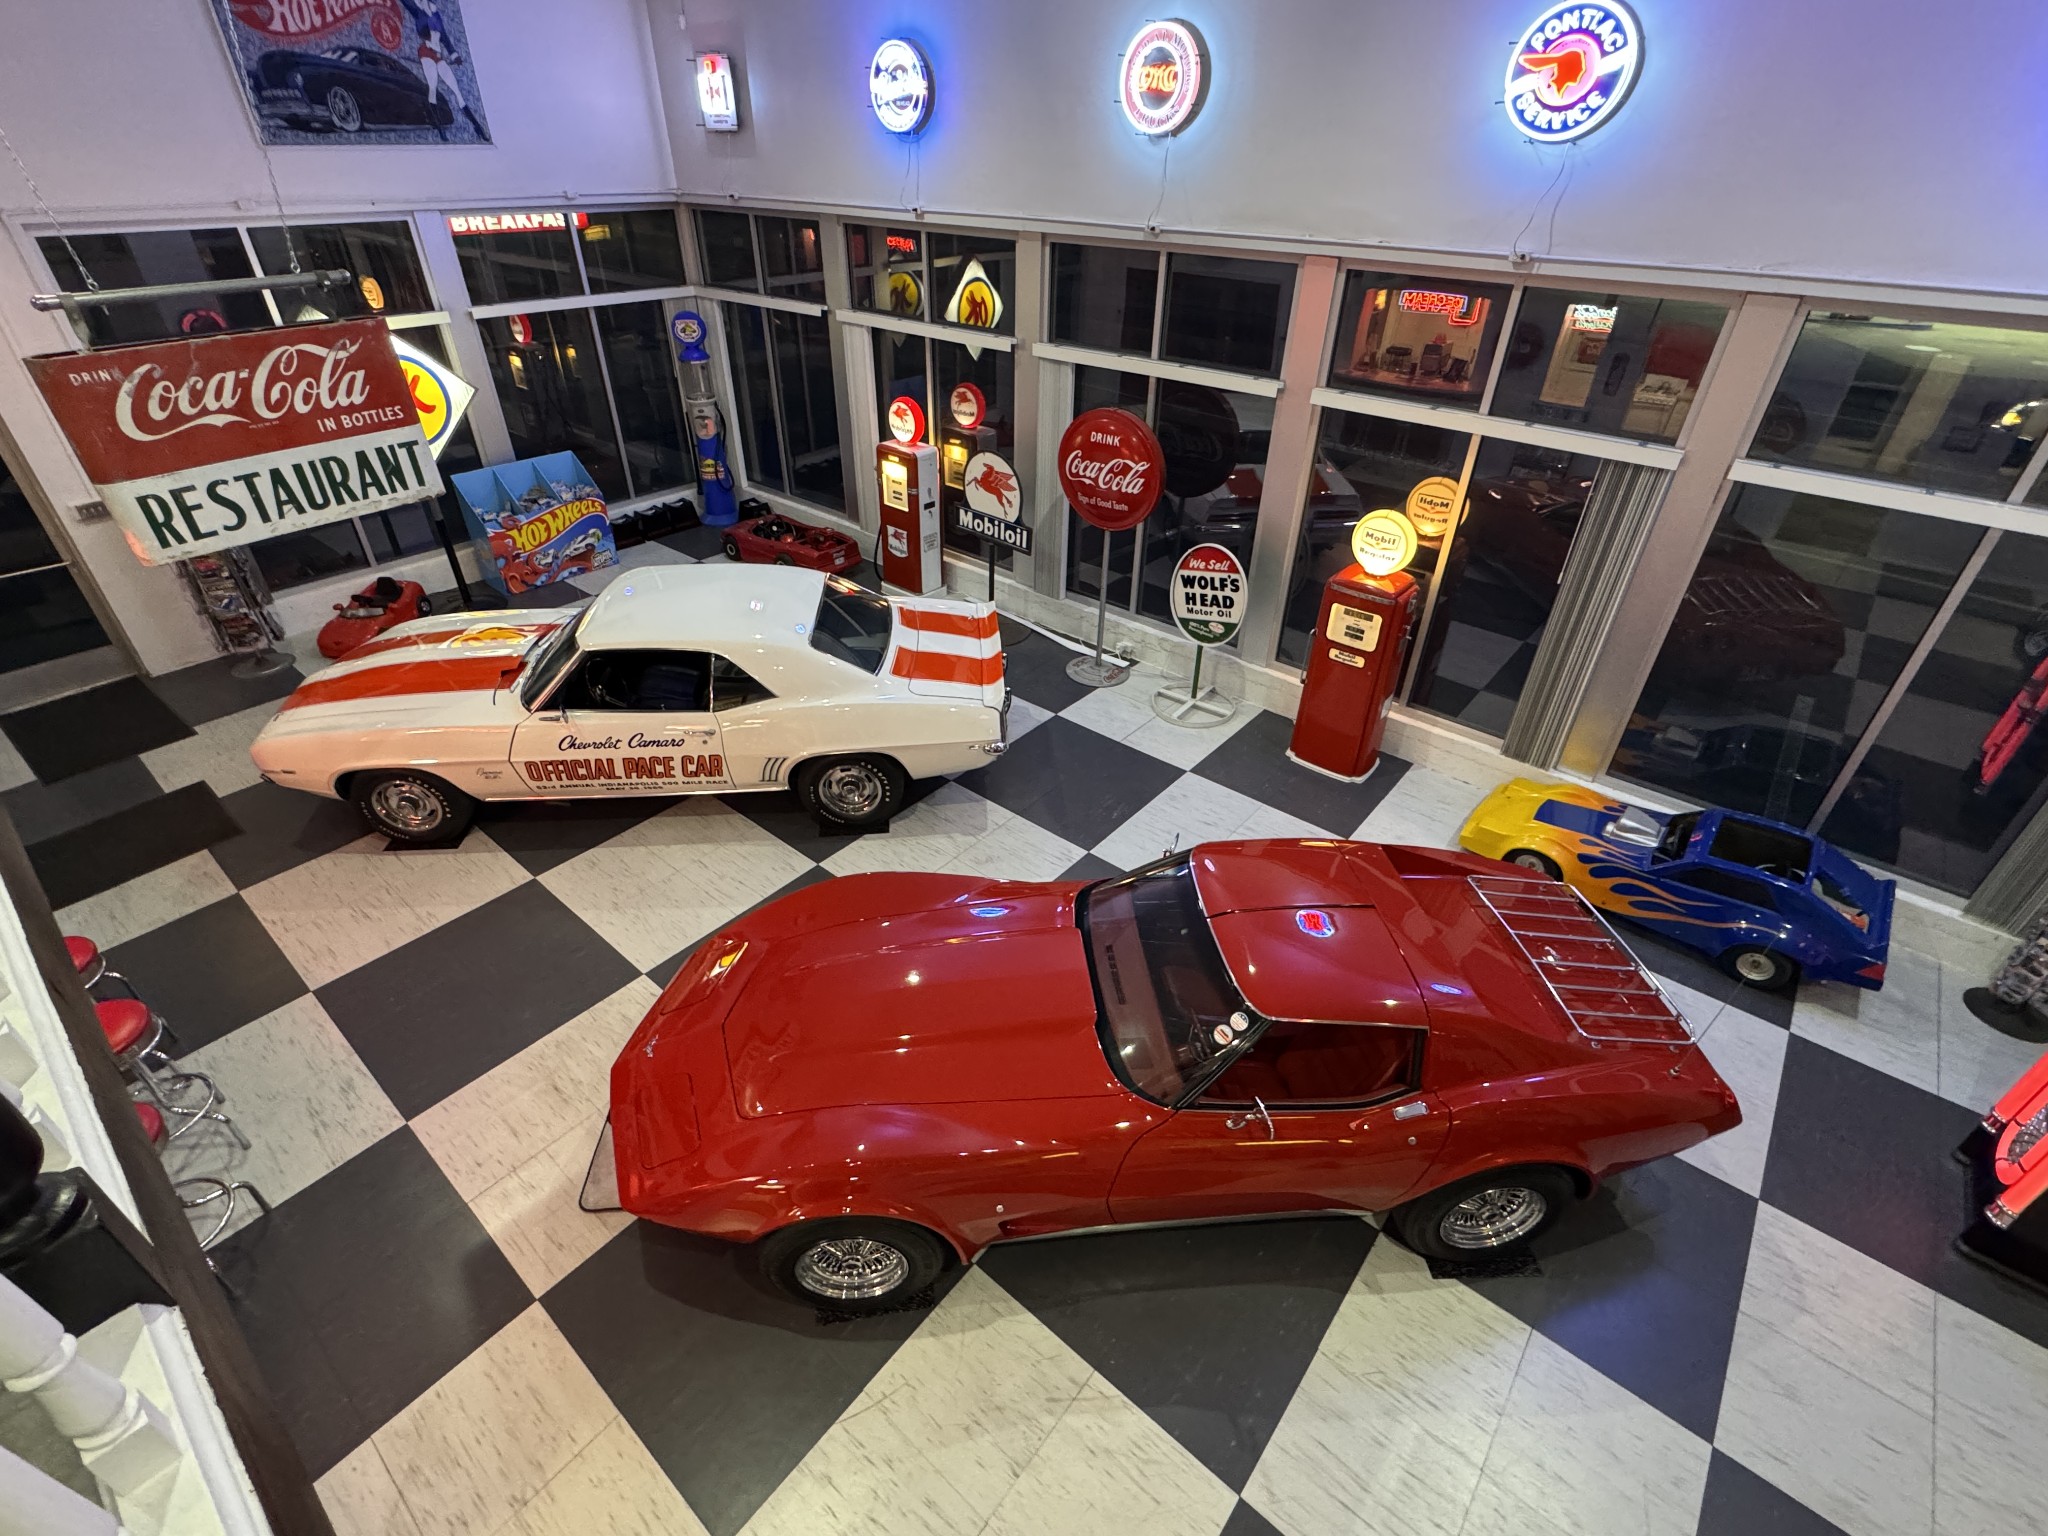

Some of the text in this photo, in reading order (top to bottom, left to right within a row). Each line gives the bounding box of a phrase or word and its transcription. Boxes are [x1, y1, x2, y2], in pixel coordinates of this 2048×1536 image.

[1530, 8, 1625, 53] PONTIAC
[1516, 90, 1607, 130] SERVICE
[68, 368, 119, 387] DRIN
[115, 337, 370, 442] Coca-Cola
[402, 368, 437, 414] K
[317, 405, 405, 433] IN BOTTLES
[1090, 431, 1121, 447] DRINK
[1065, 449, 1151, 495] Coca-Cola
[135, 440, 427, 550] RESTAURANT
[1090, 496, 1097, 505] of
[1097, 498, 1112, 509] Good
[1112, 500, 1129, 511] Taste
[506, 519, 549, 553] HOT
[958, 508, 1028, 550] Mobiloil
[1365, 531, 1397, 546] Mobil
[1189, 558, 1230, 571] We Sell
[1180, 574, 1240, 593] WOLF'S
[1185, 591, 1235, 609] HEAD
[1186, 606, 1232, 618] Motor Oil
[558, 732, 685, 751] Chevrolet Camaro
[524, 754, 724, 782] OFFICIAL PACE CAR
